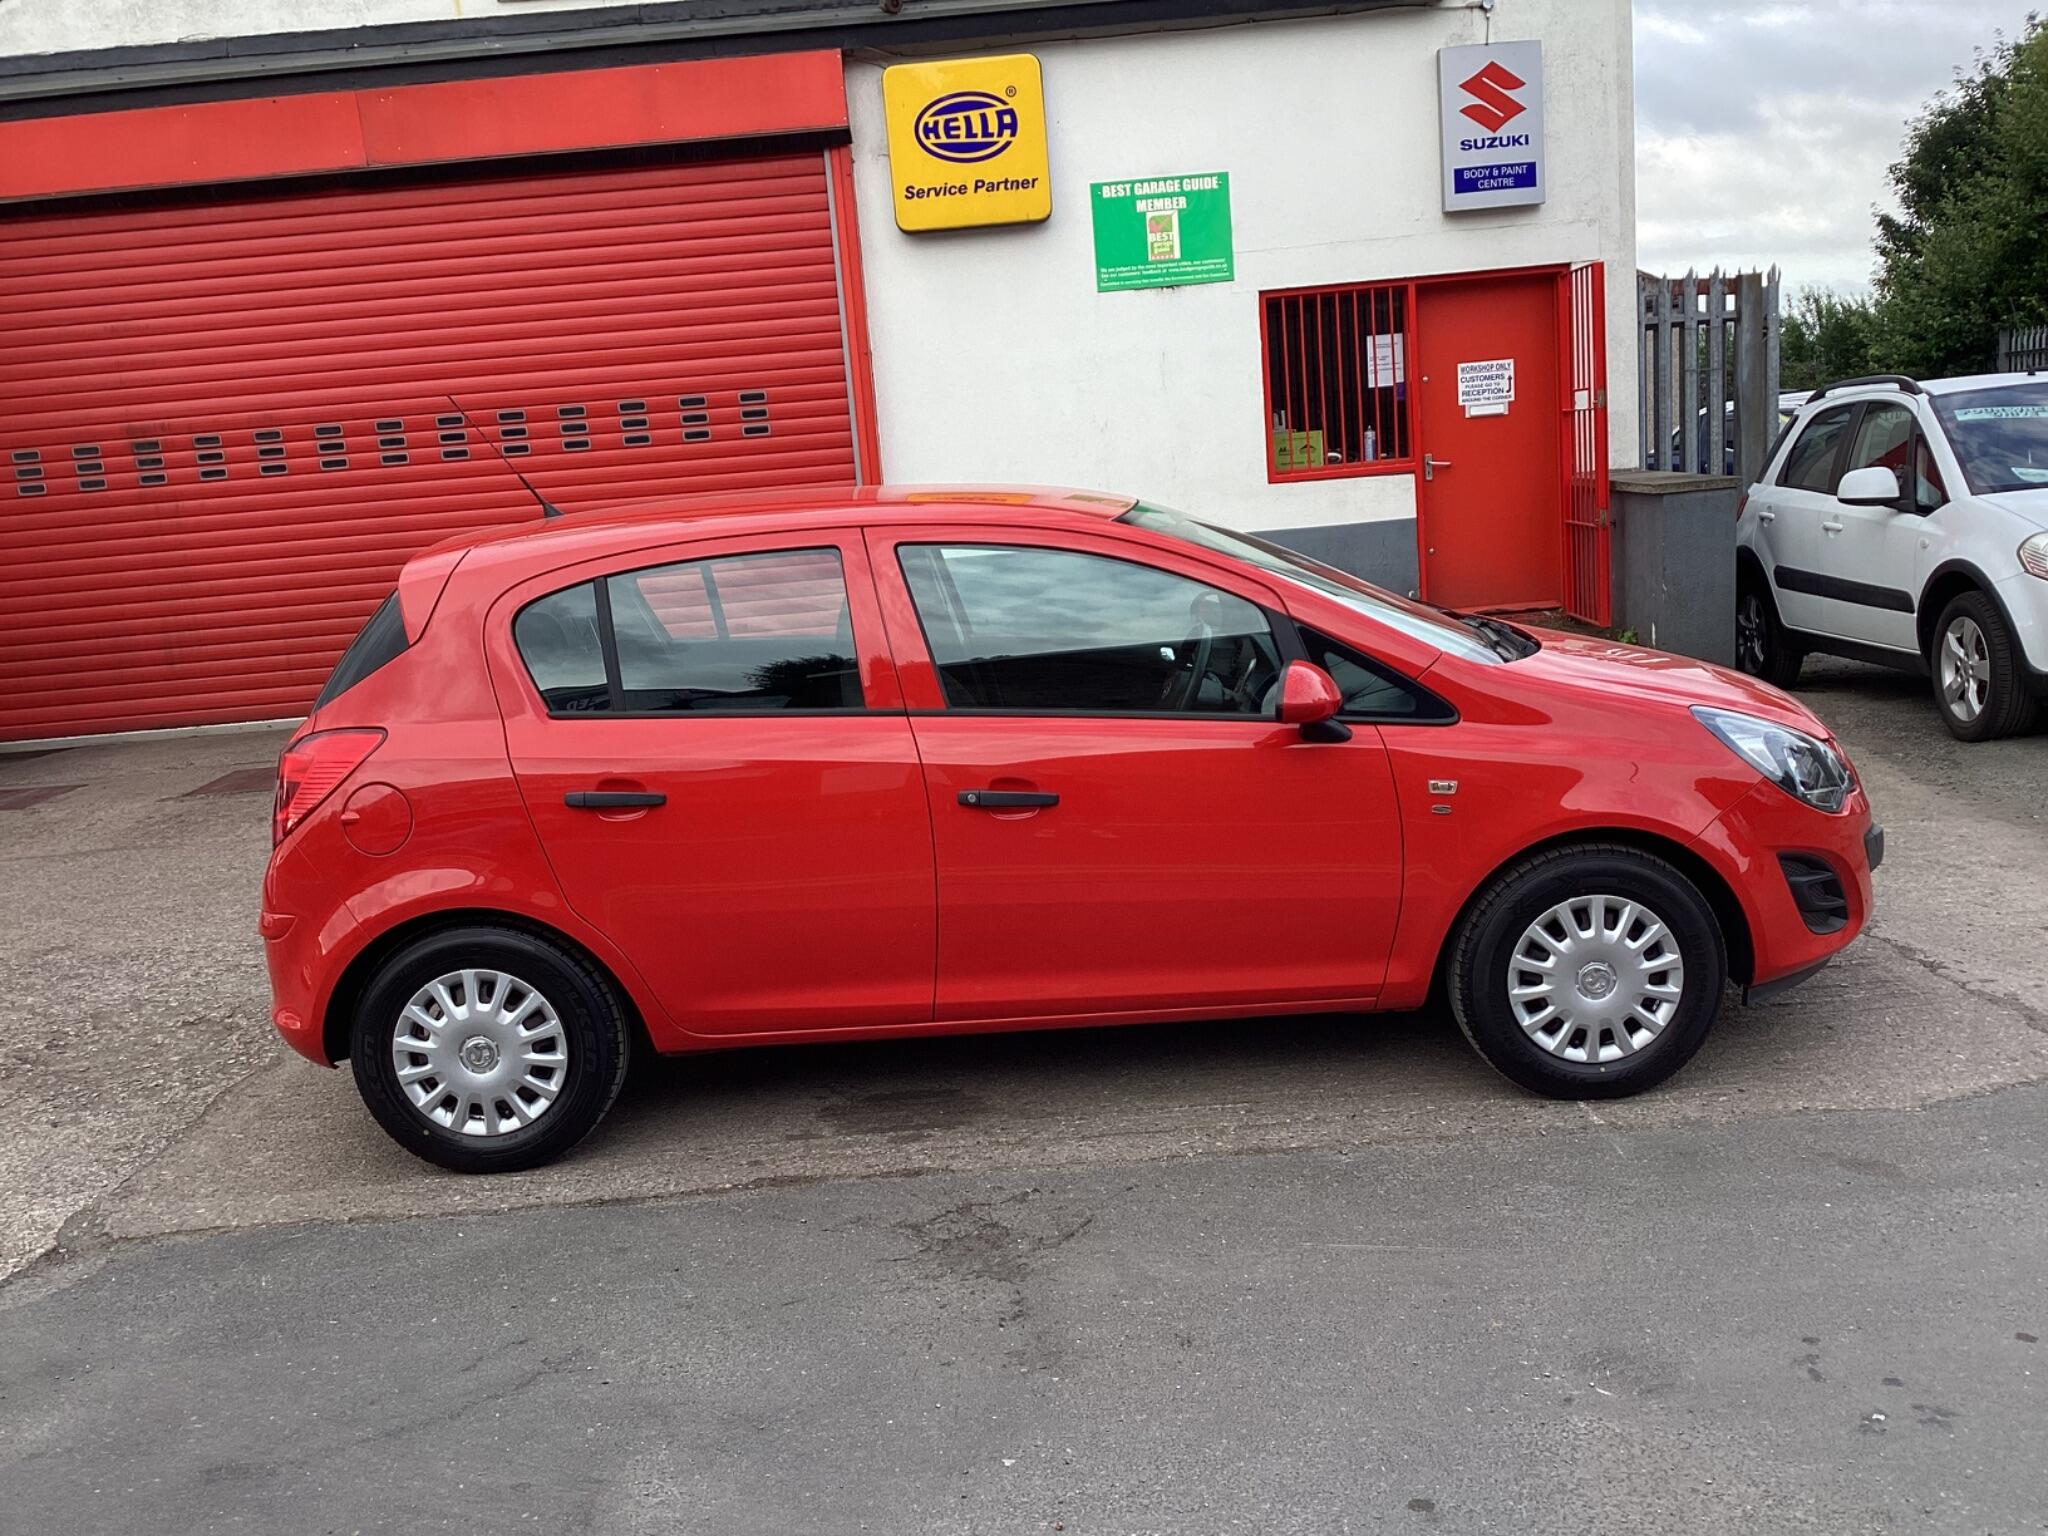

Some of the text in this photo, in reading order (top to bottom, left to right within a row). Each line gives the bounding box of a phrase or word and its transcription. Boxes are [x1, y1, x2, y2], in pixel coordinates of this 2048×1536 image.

[922, 107, 1018, 140] HELLA
[1460, 134, 1529, 151] SUZUKI
[1463, 165, 1528, 179] BODY & PAINT
[904, 177, 1039, 200] Service Partner
[1134, 180, 1180, 196] GARAGE
[1477, 177, 1515, 189] CENTRE
[1136, 196, 1187, 213] MEMBER
[1149, 231, 1173, 242] BEST
[1460, 362, 1511, 374] WORKSHOP ONLY
[1460, 373, 1505, 383] CUSTOMERS
[1461, 387, 1504, 397] RECEPTION
